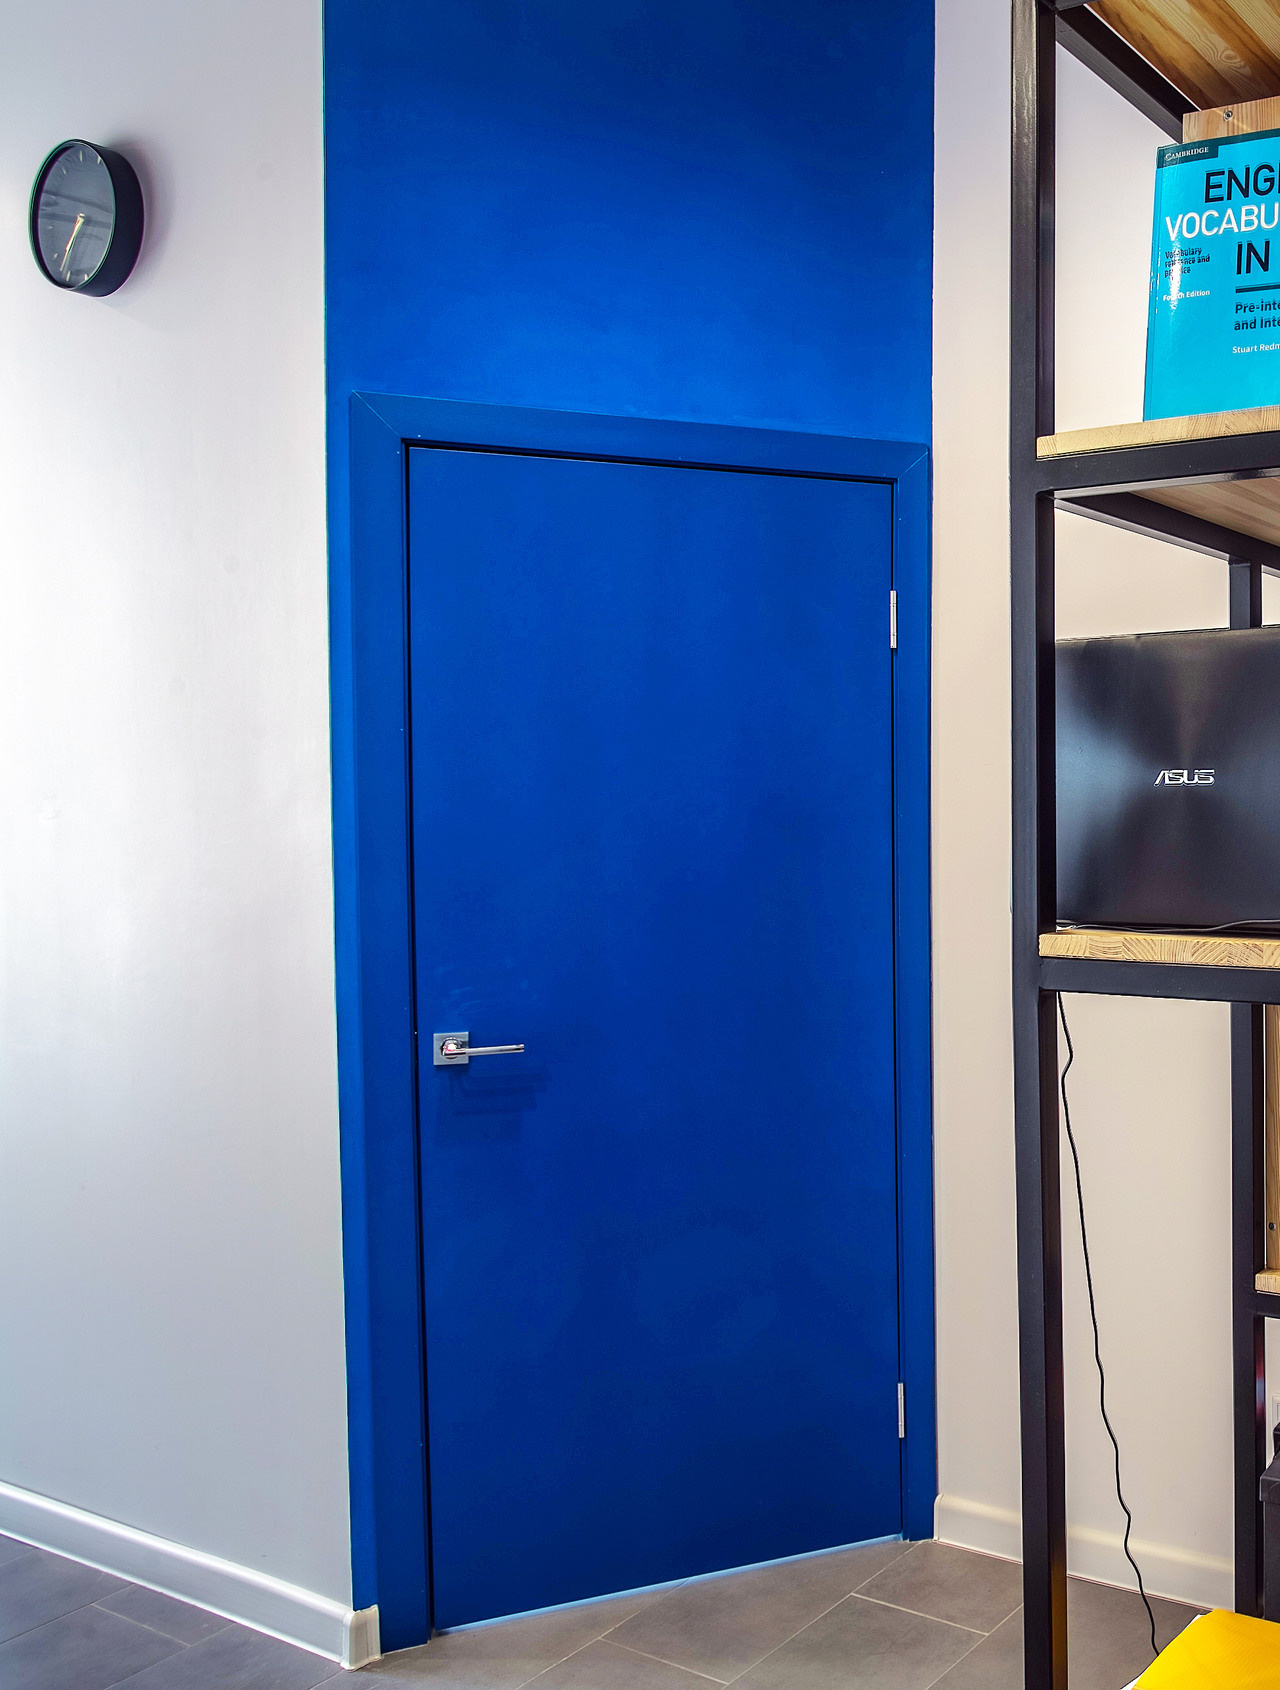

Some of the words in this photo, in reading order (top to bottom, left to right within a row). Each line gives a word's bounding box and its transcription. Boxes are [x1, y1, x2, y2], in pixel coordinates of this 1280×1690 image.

[1165, 147, 1209, 161] CAMBRIDGE
[1197, 254, 1210, 264] and
[1236, 238, 1270, 275] IN
[1163, 292, 1184, 301] Foth
[1234, 317, 1256, 330] and
[1232, 345, 1258, 354] Stuart
[1154, 770, 1215, 787] ASUS
